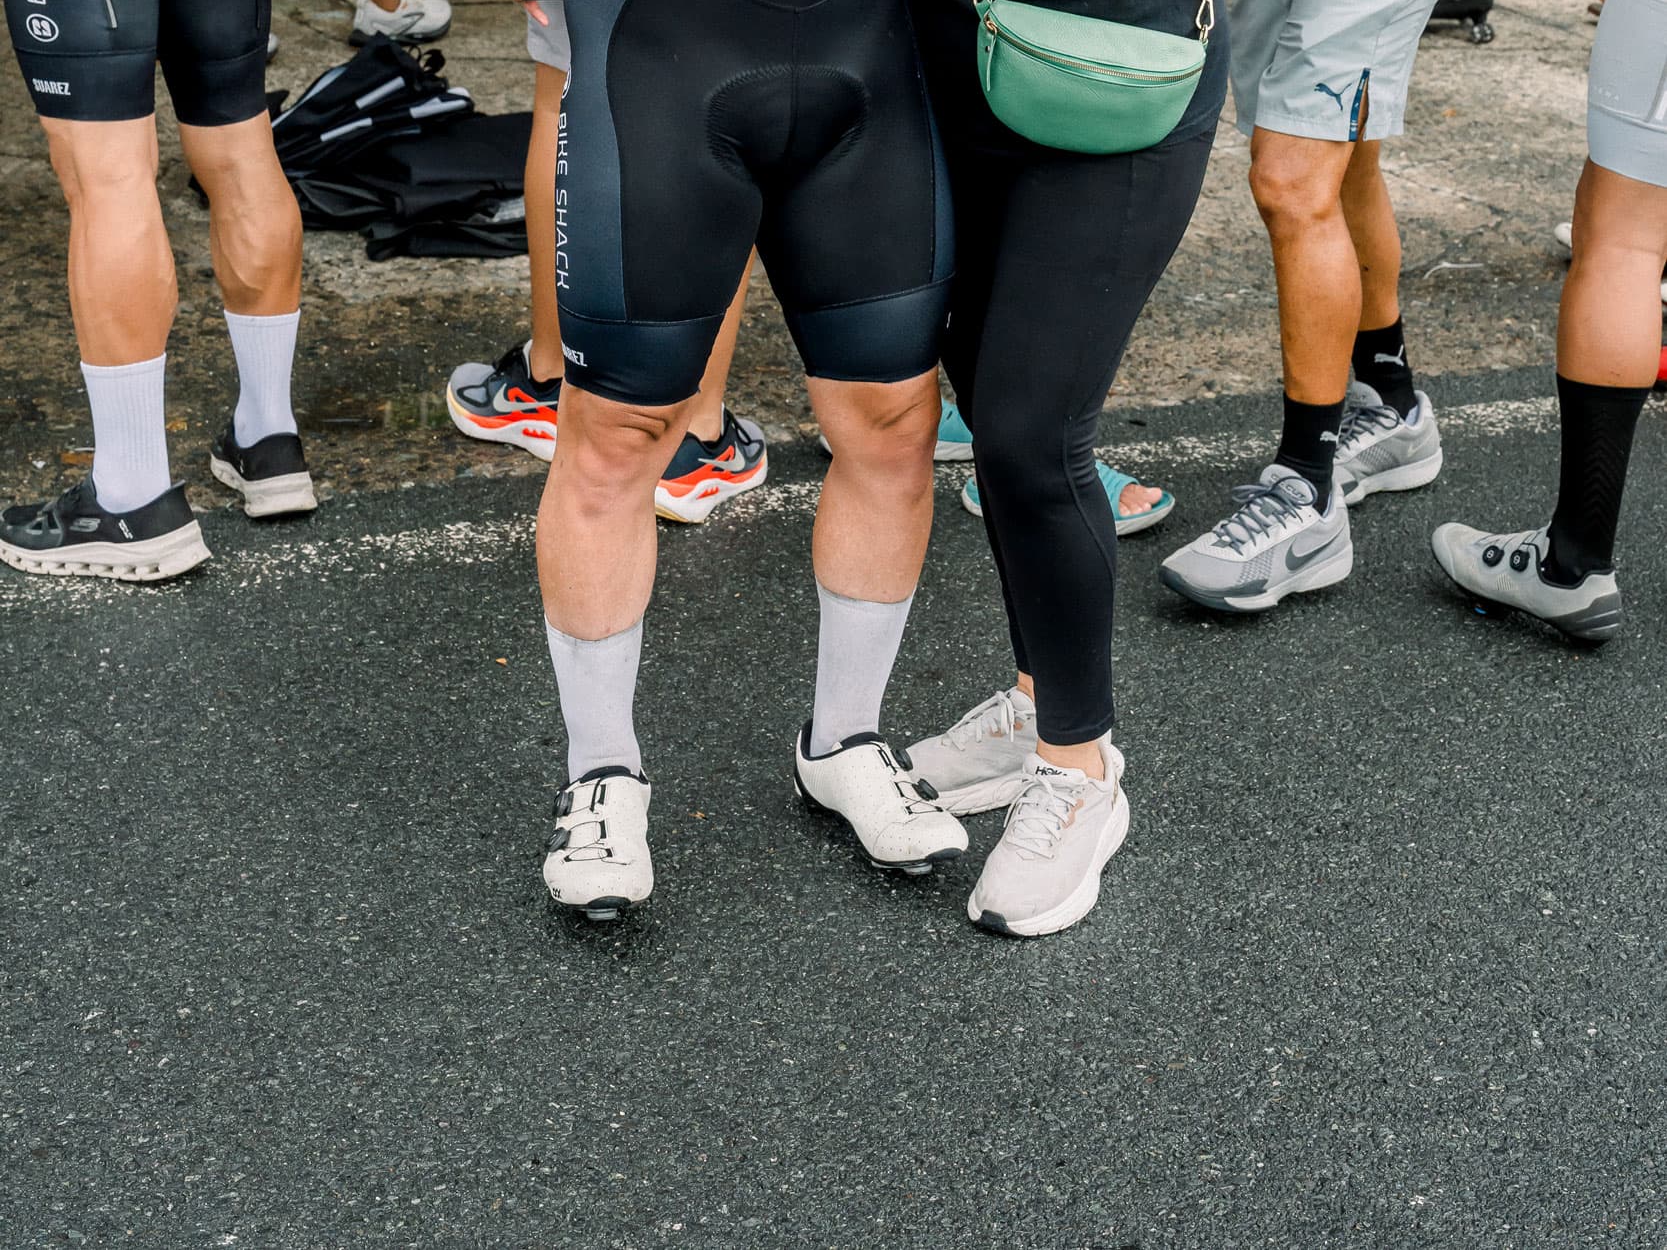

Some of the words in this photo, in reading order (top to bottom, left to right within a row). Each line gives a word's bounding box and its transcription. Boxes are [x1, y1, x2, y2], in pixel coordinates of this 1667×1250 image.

[32, 78, 72, 96] SUAREZ
[558, 111, 569, 177] BIKE
[554, 188, 571, 290] SHACK
